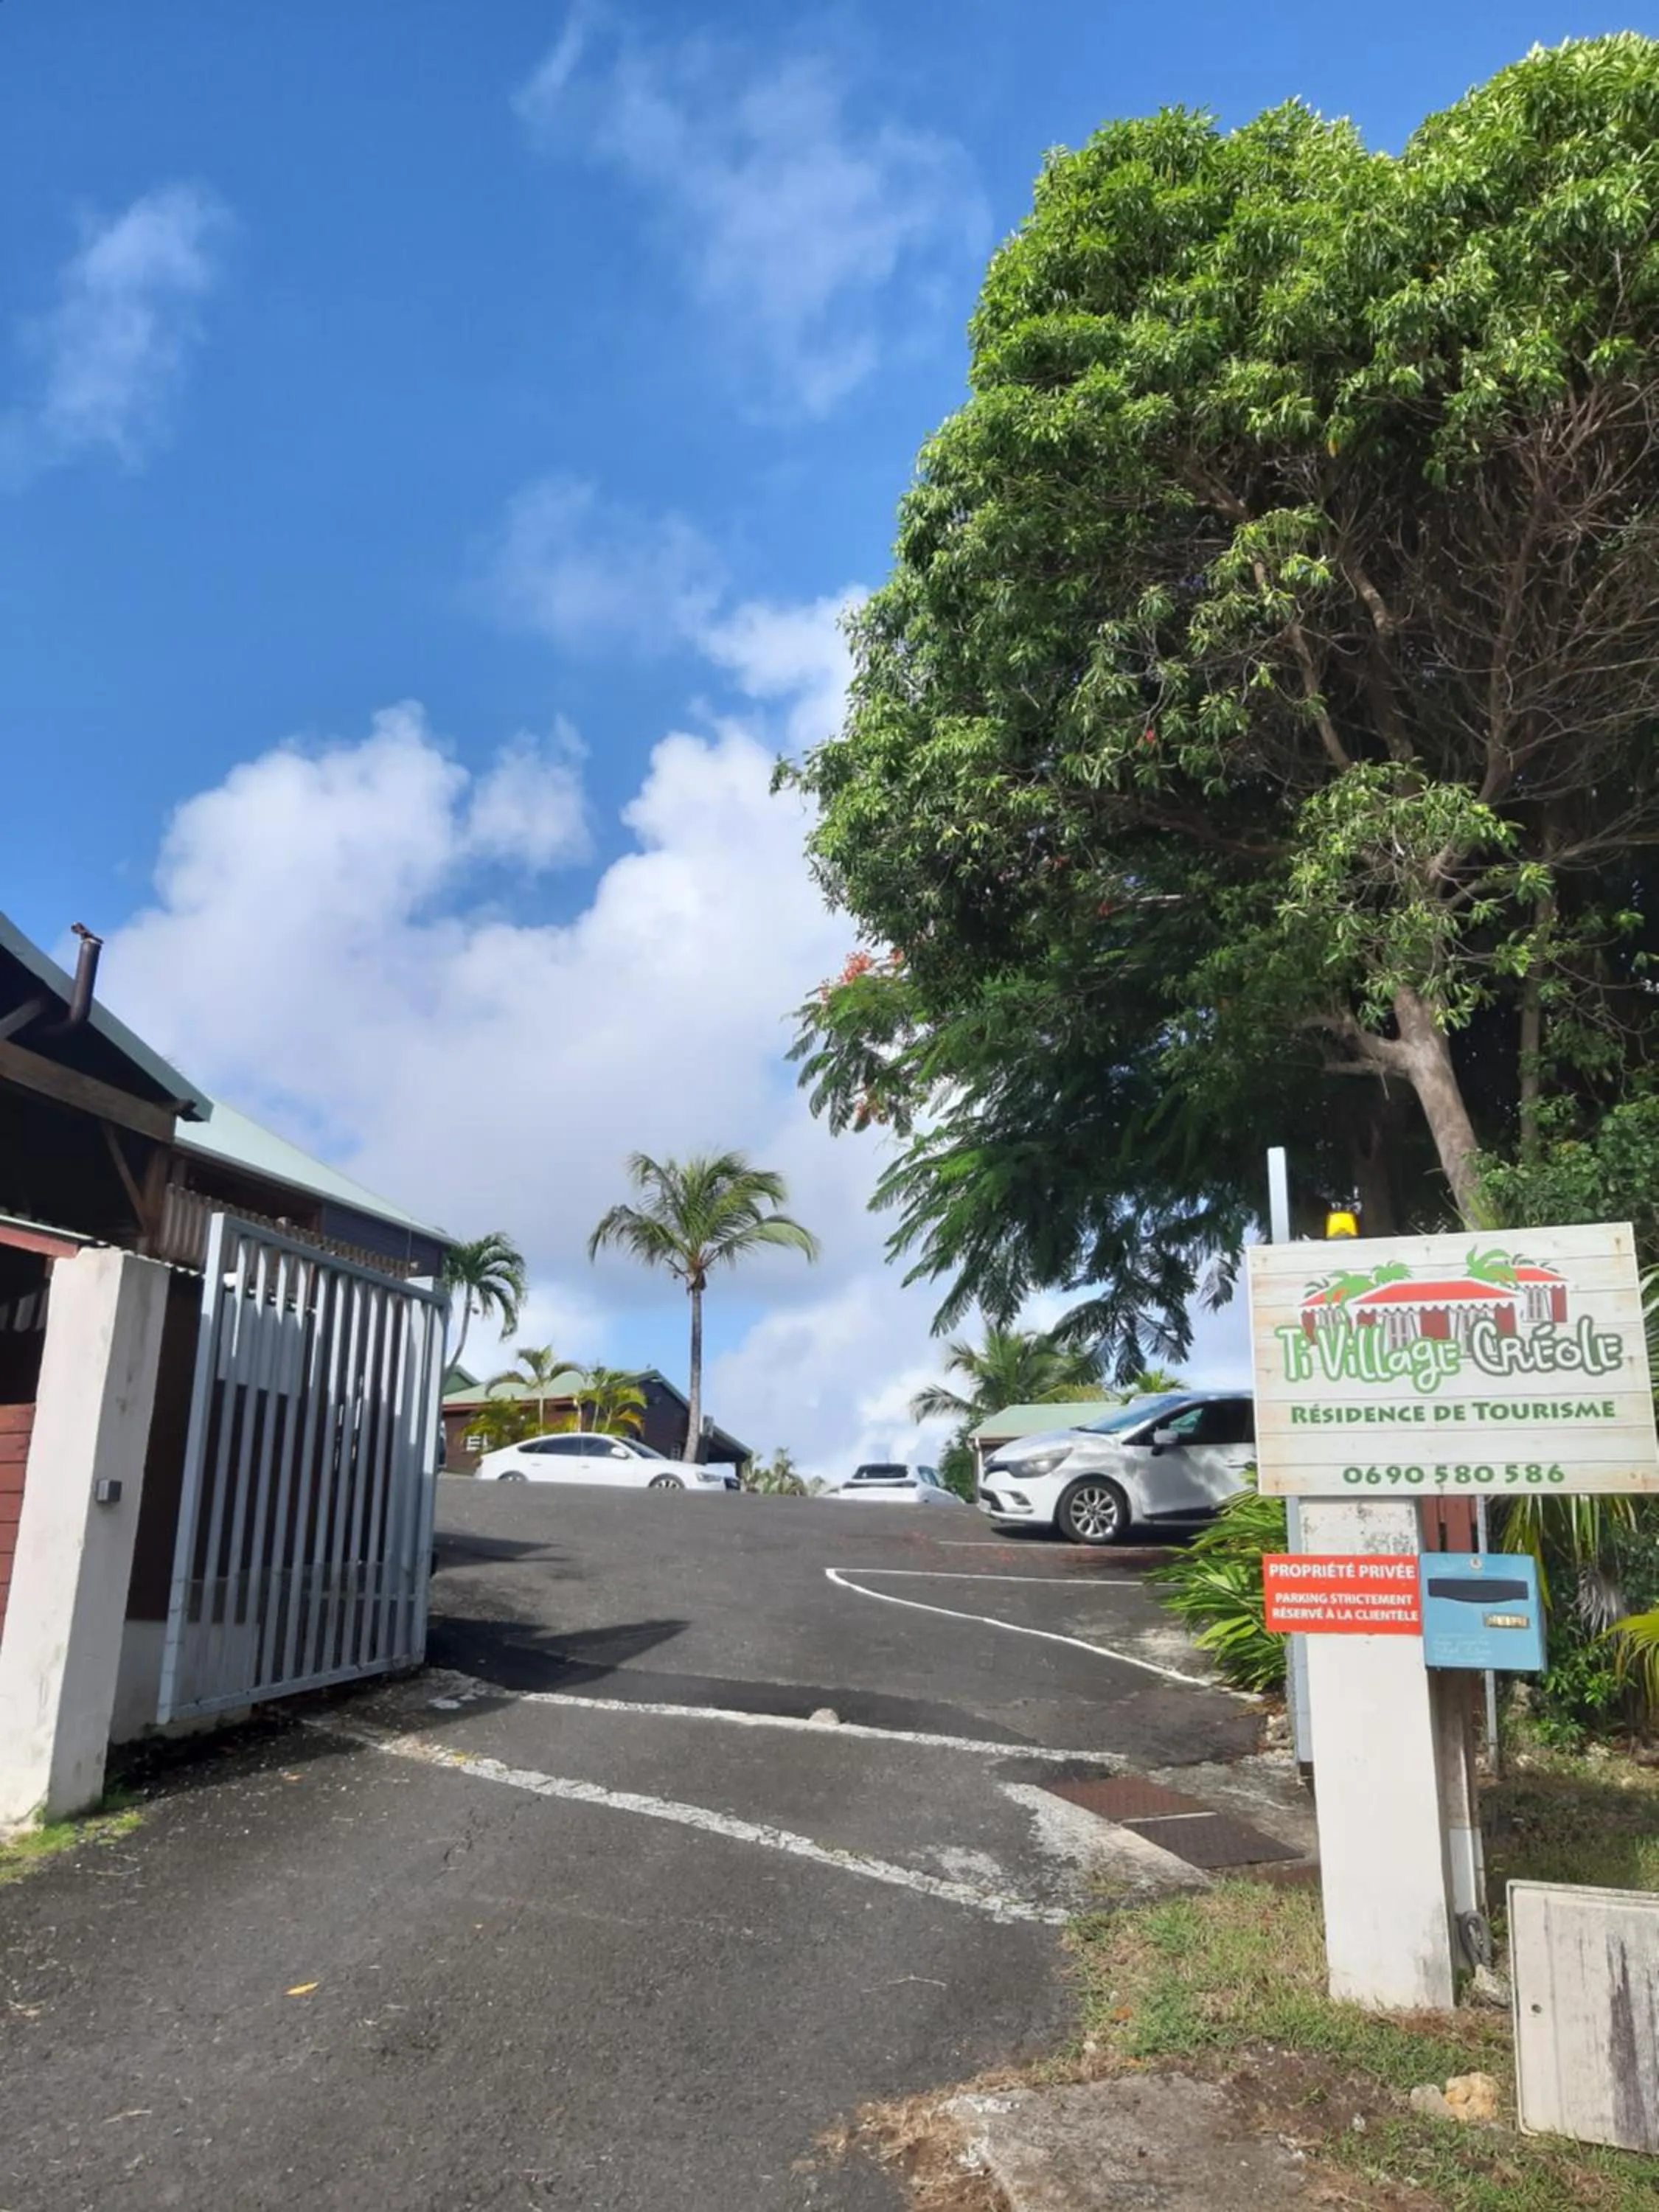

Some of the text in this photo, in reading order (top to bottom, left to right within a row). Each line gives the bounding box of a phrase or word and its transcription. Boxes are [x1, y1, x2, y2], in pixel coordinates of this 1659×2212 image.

[1276, 1324, 1313, 1382] Ti
[1291, 1400, 1615, 1425] RÉSIDENCE DE TOURISME
[1343, 1464, 1565, 1485] 0690 580 586
[1269, 1562, 1415, 1579] PROPRIÉTÉ PRIVÉE
[1275, 1592, 1413, 1605] PARKING STRICTEMENT
[1272, 1607, 1324, 1620] RÉSERVÉ
[1326, 1607, 1335, 1620] À
[1336, 1609, 1352, 1621] LA
